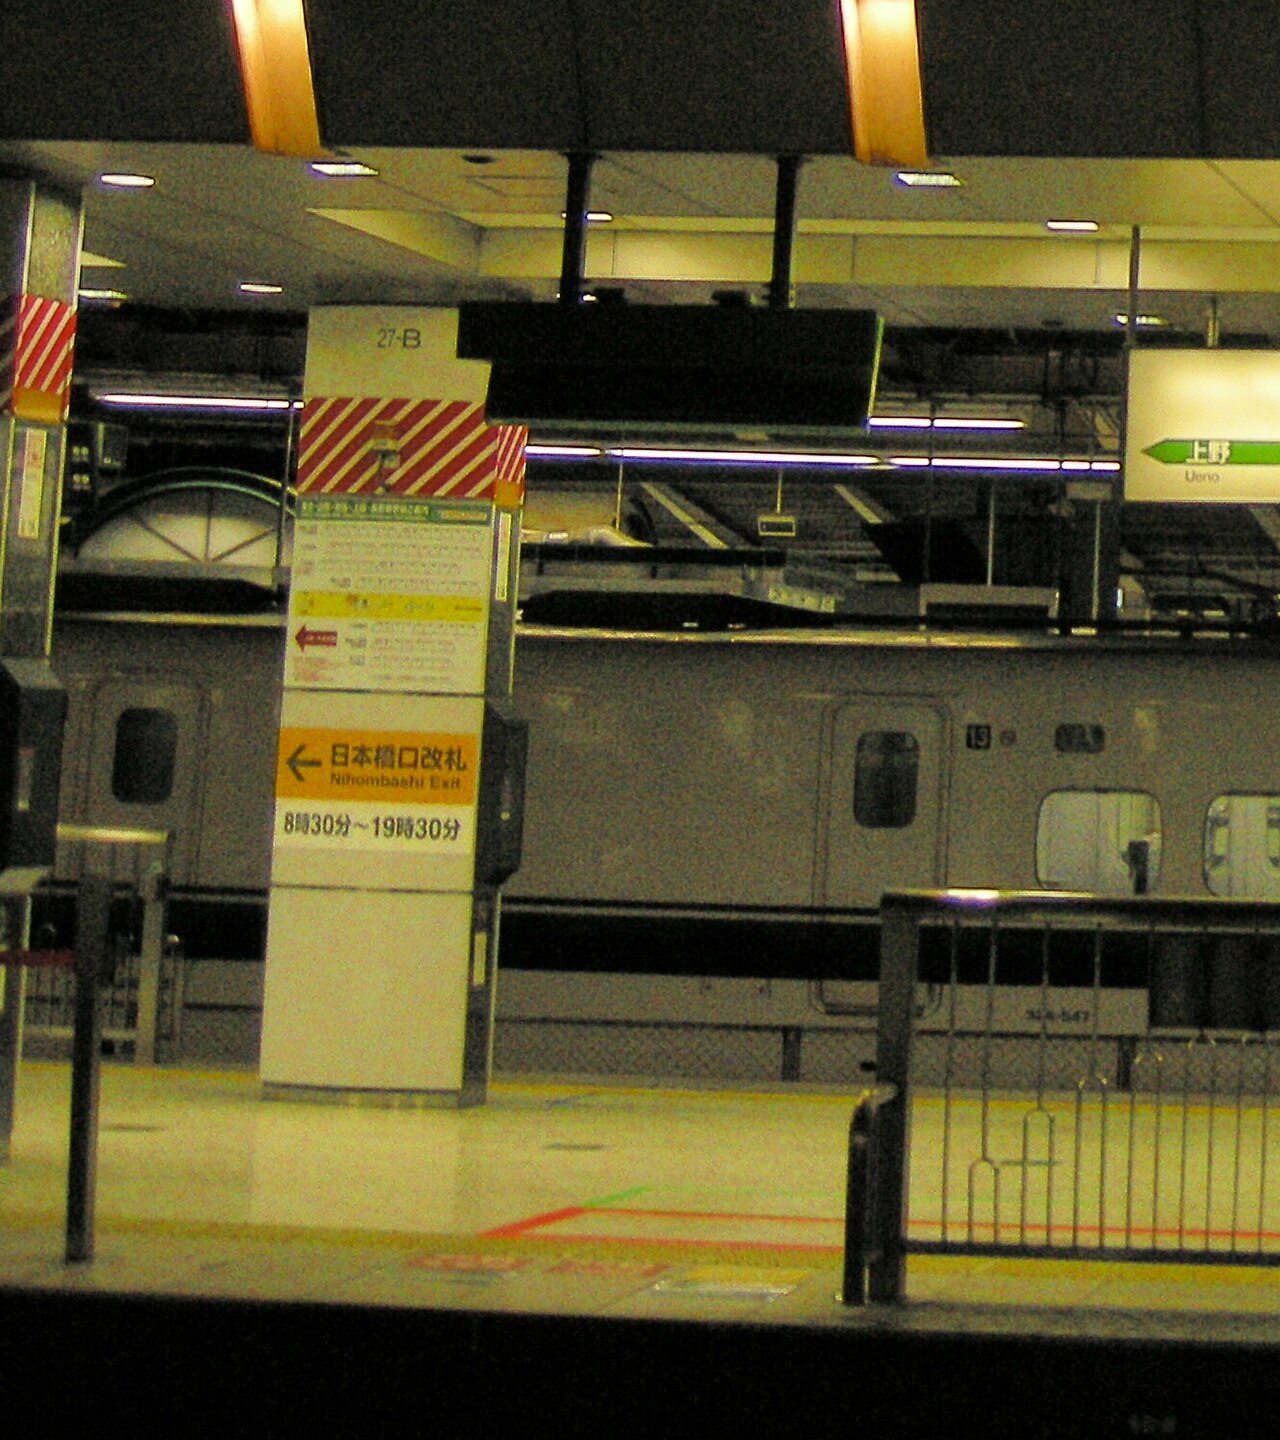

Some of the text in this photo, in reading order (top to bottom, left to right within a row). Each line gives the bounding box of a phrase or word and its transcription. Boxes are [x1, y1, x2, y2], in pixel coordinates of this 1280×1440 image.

[377, 328, 421, 349] 27-B
[1184, 440, 1231, 465] 上野
[1184, 470, 1220, 483] Ueno
[331, 743, 467, 772] 日本橋口改札
[330, 772, 461, 791] Nihombashi Exit
